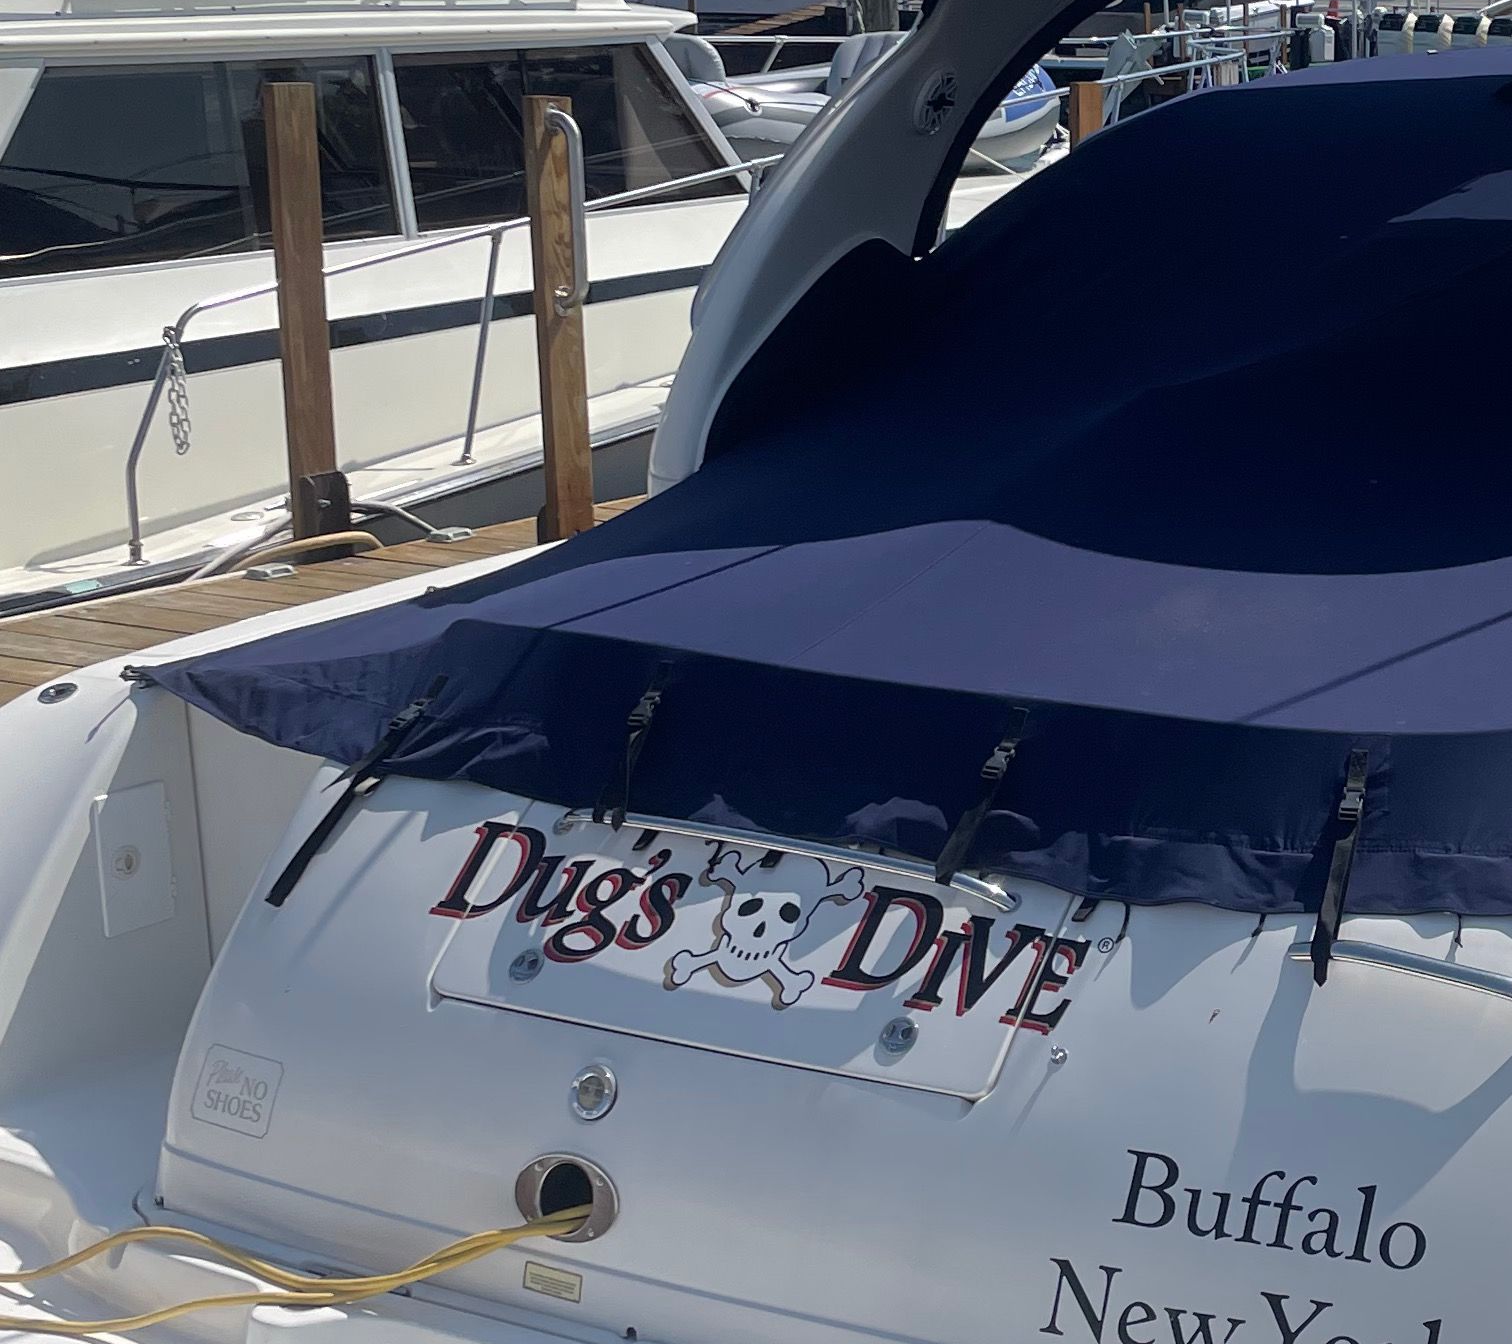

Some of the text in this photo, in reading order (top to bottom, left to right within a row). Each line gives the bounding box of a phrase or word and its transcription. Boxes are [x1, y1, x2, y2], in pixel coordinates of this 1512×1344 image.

[429, 820, 693, 963] Dug's
[203, 1088, 263, 1123] SHOES
[239, 1076, 268, 1101] NO
[1111, 1148, 1428, 1270] Buffalo
